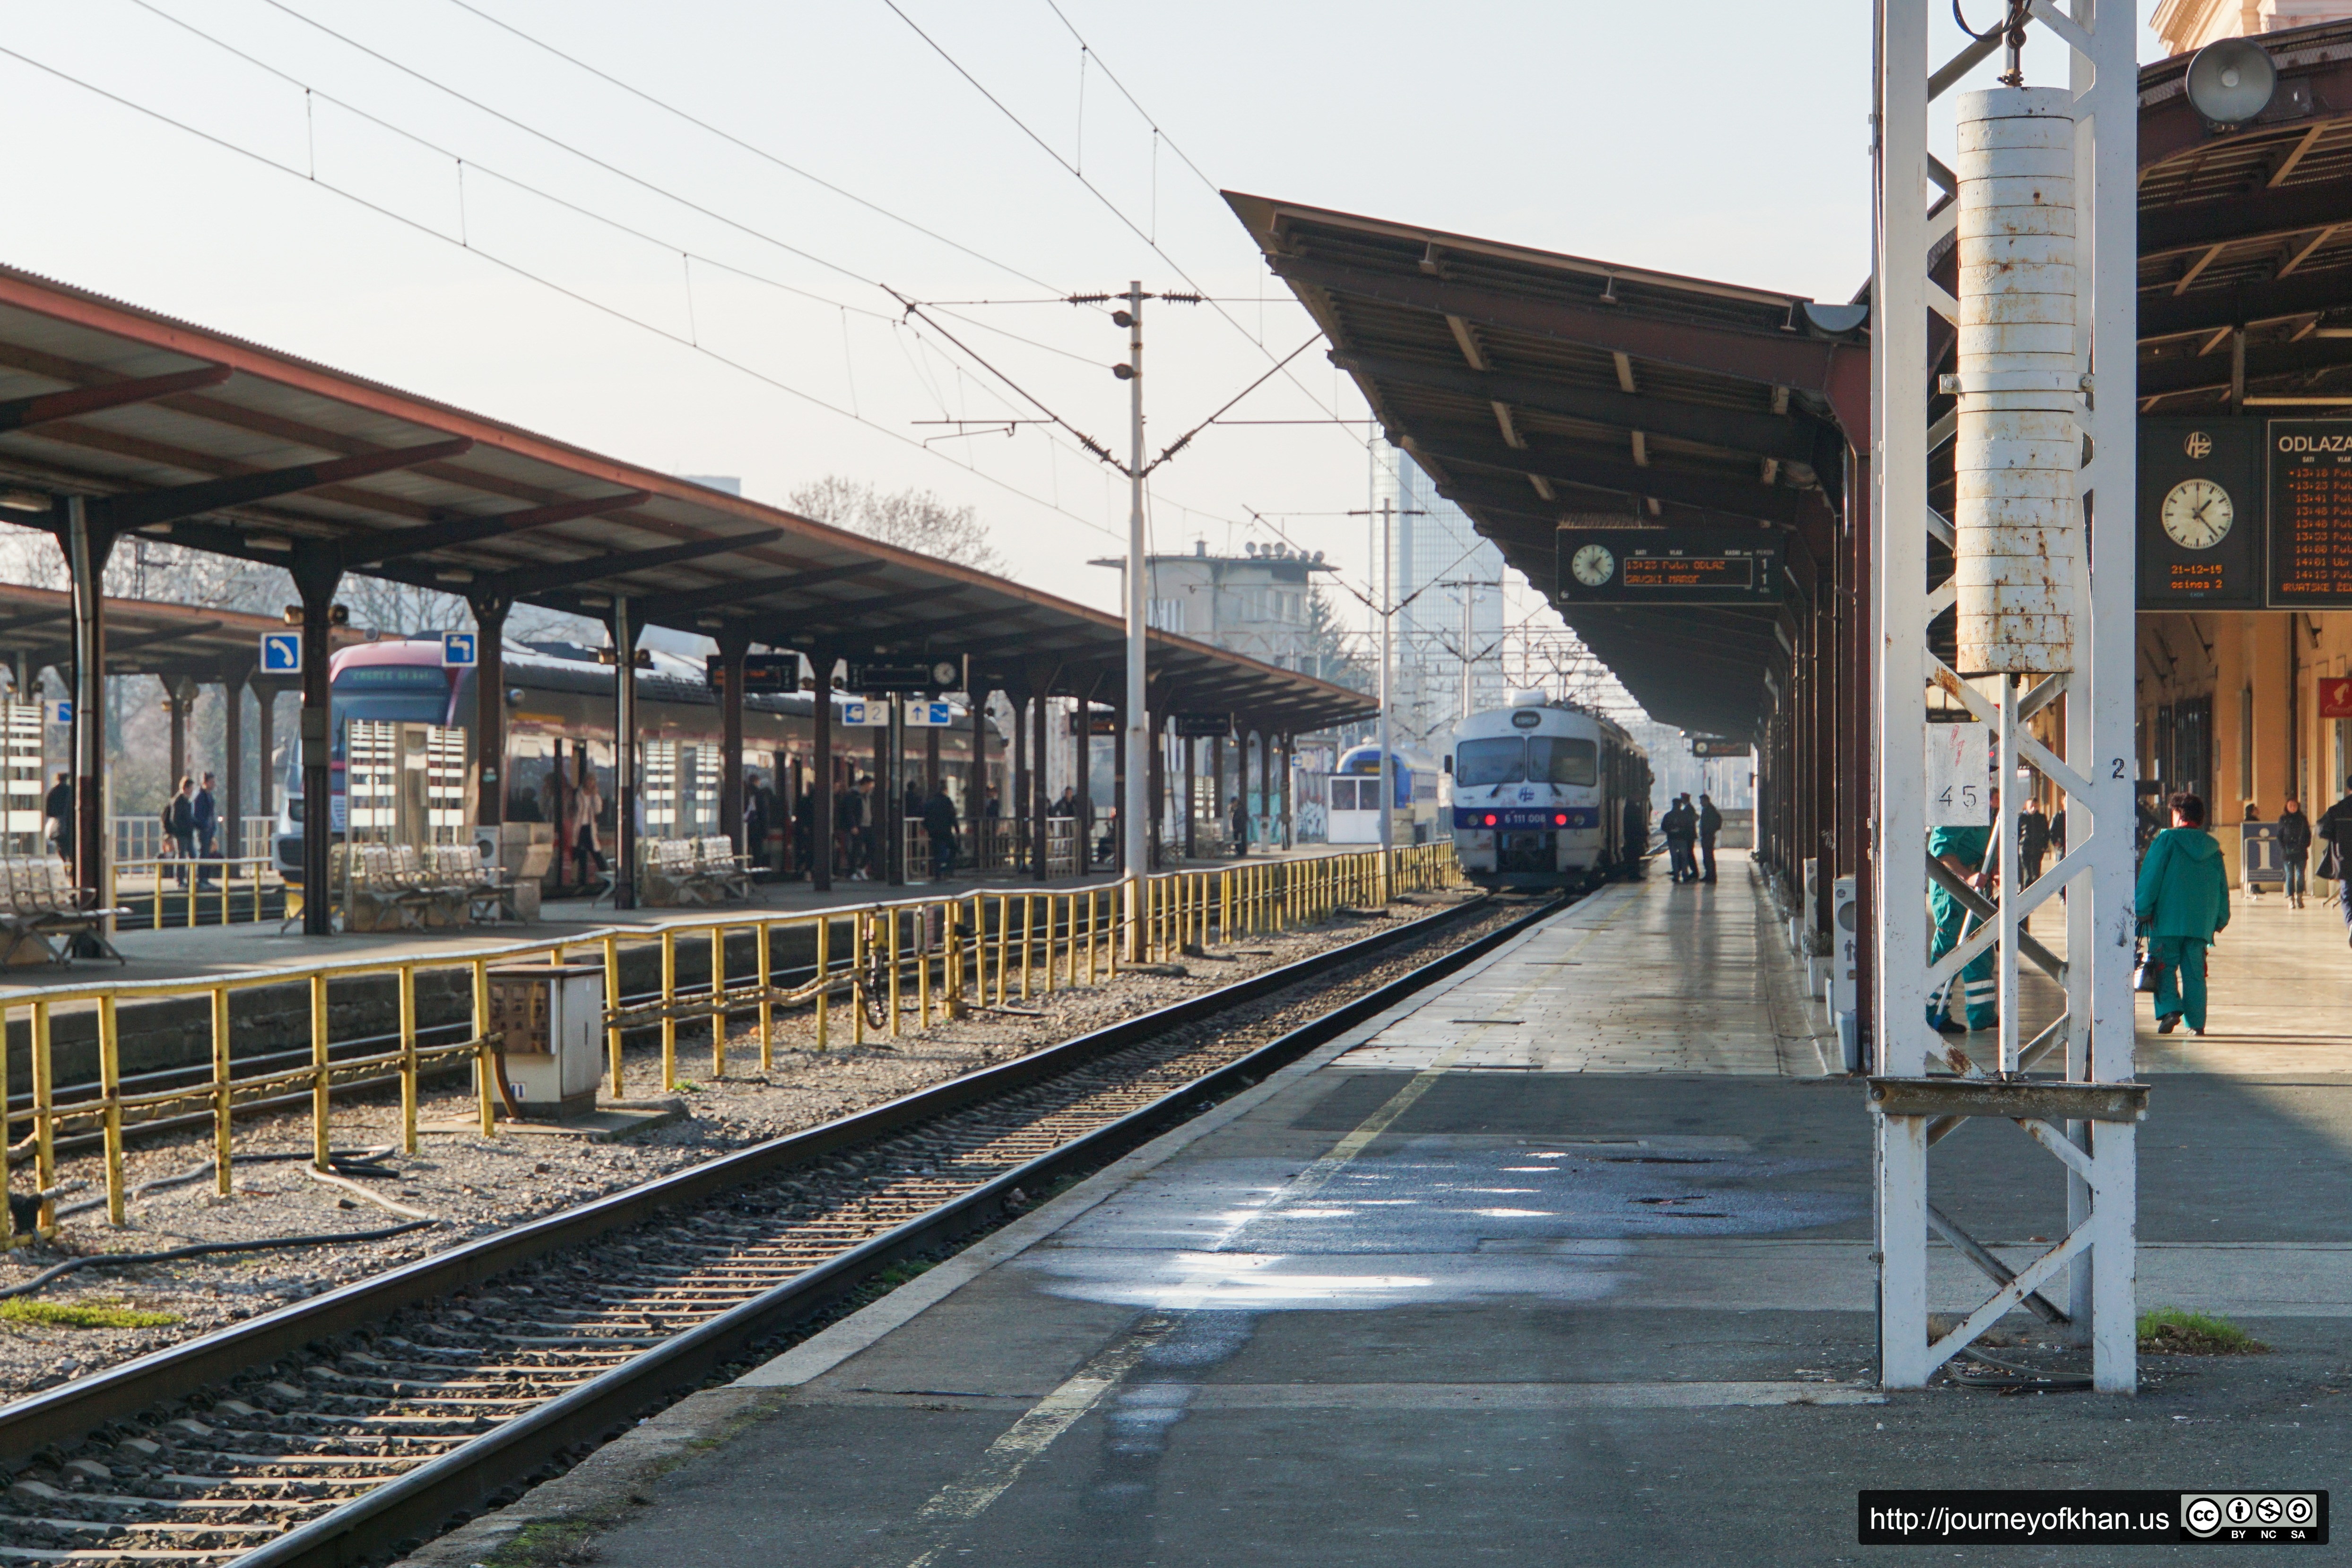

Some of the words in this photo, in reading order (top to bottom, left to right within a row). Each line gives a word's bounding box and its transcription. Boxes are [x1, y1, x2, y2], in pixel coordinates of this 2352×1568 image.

[1762, 558, 1767, 570] 1
[2171, 564, 2222, 574] 21-12-15
[1762, 573, 1767, 585] 1
[2215, 579, 2222, 589] 2
[871, 706, 882, 721] 2
[2112, 758, 2125, 779] 2
